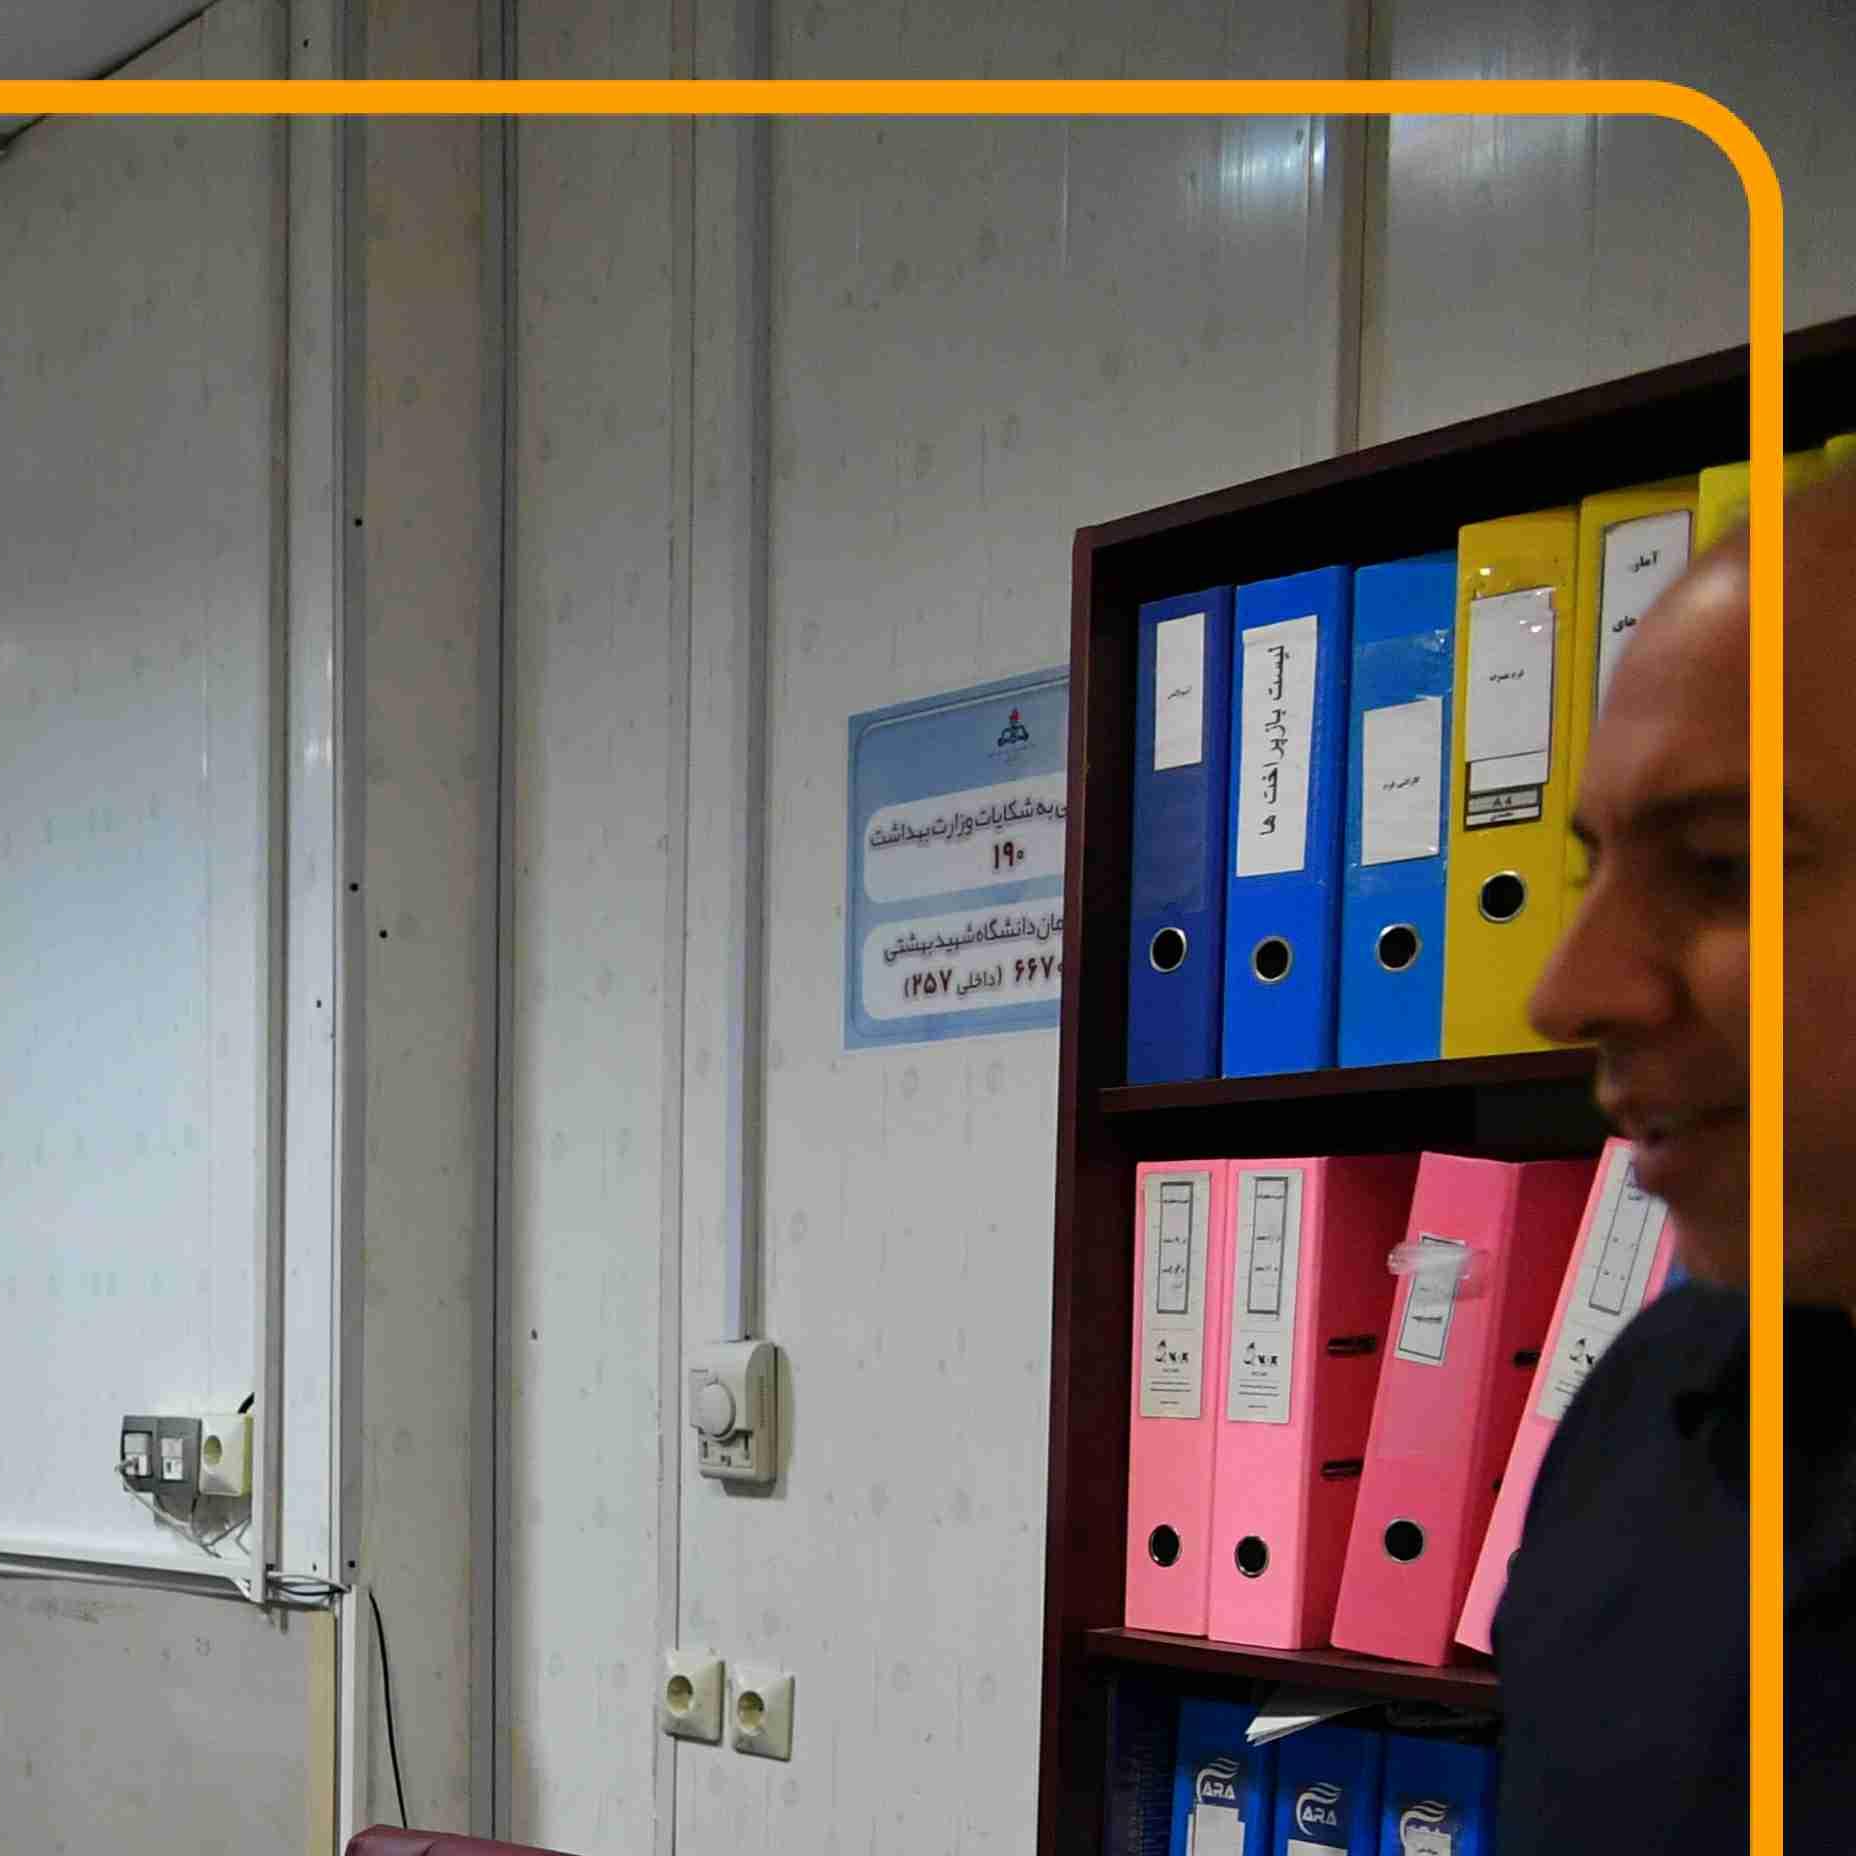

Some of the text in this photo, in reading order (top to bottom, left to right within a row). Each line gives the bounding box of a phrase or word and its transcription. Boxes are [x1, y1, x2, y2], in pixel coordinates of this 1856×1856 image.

[1267, 645, 1291, 701] لیست
[931, 810, 975, 840] وزارت
[975, 797, 1034, 830] شکایات
[1036, 801, 1053, 820] به
[1259, 815, 1277, 836] ها
[869, 822, 930, 847] بهداشت
[934, 920, 975, 952] شهید
[976, 916, 1036, 943] دانشگاه
[883, 931, 933, 962] بهشتی
